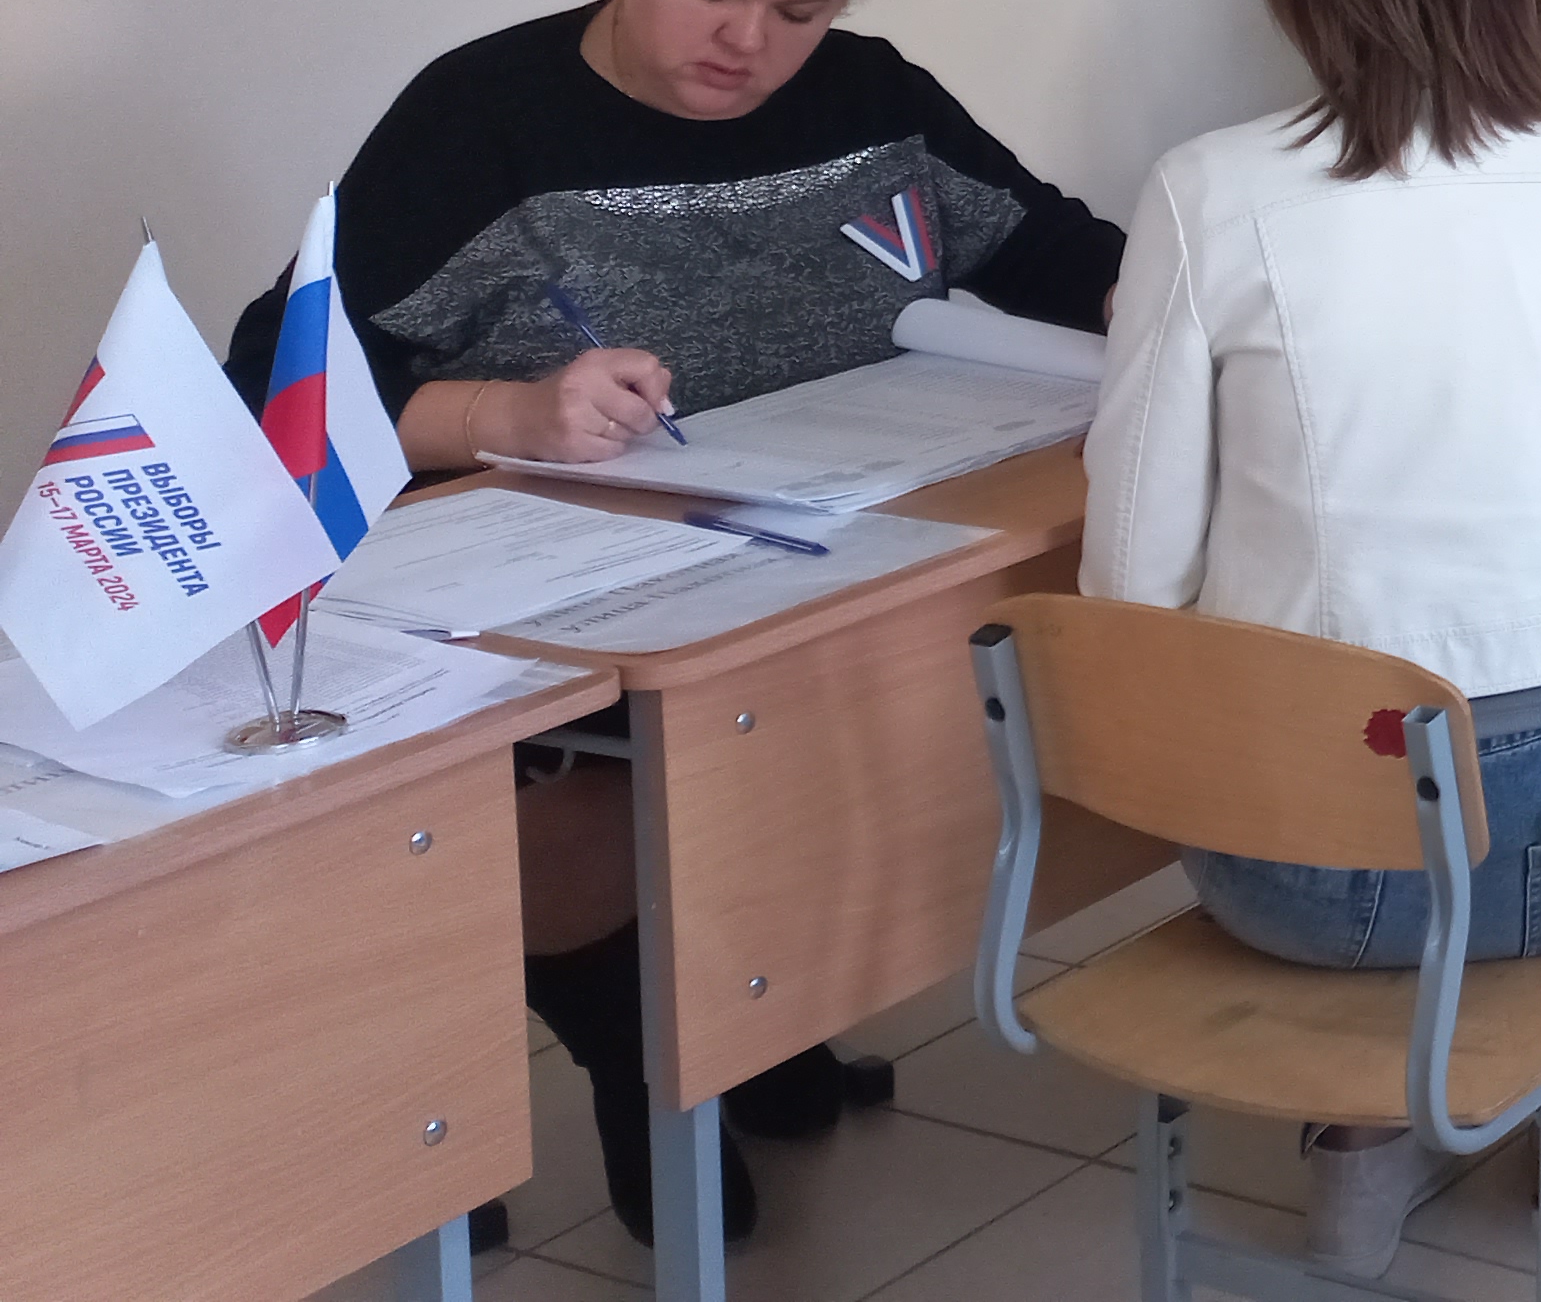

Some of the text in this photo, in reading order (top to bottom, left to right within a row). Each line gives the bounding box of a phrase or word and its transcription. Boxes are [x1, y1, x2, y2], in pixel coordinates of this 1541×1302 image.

[64, 475, 144, 557] РОССИИ
[102, 468, 210, 597] ПРЕЗИДЕНТА
[140, 462, 222, 551] ВЫБОРЫ
[60, 524, 113, 575] МАРТА
[97, 576, 140, 611] 2024
